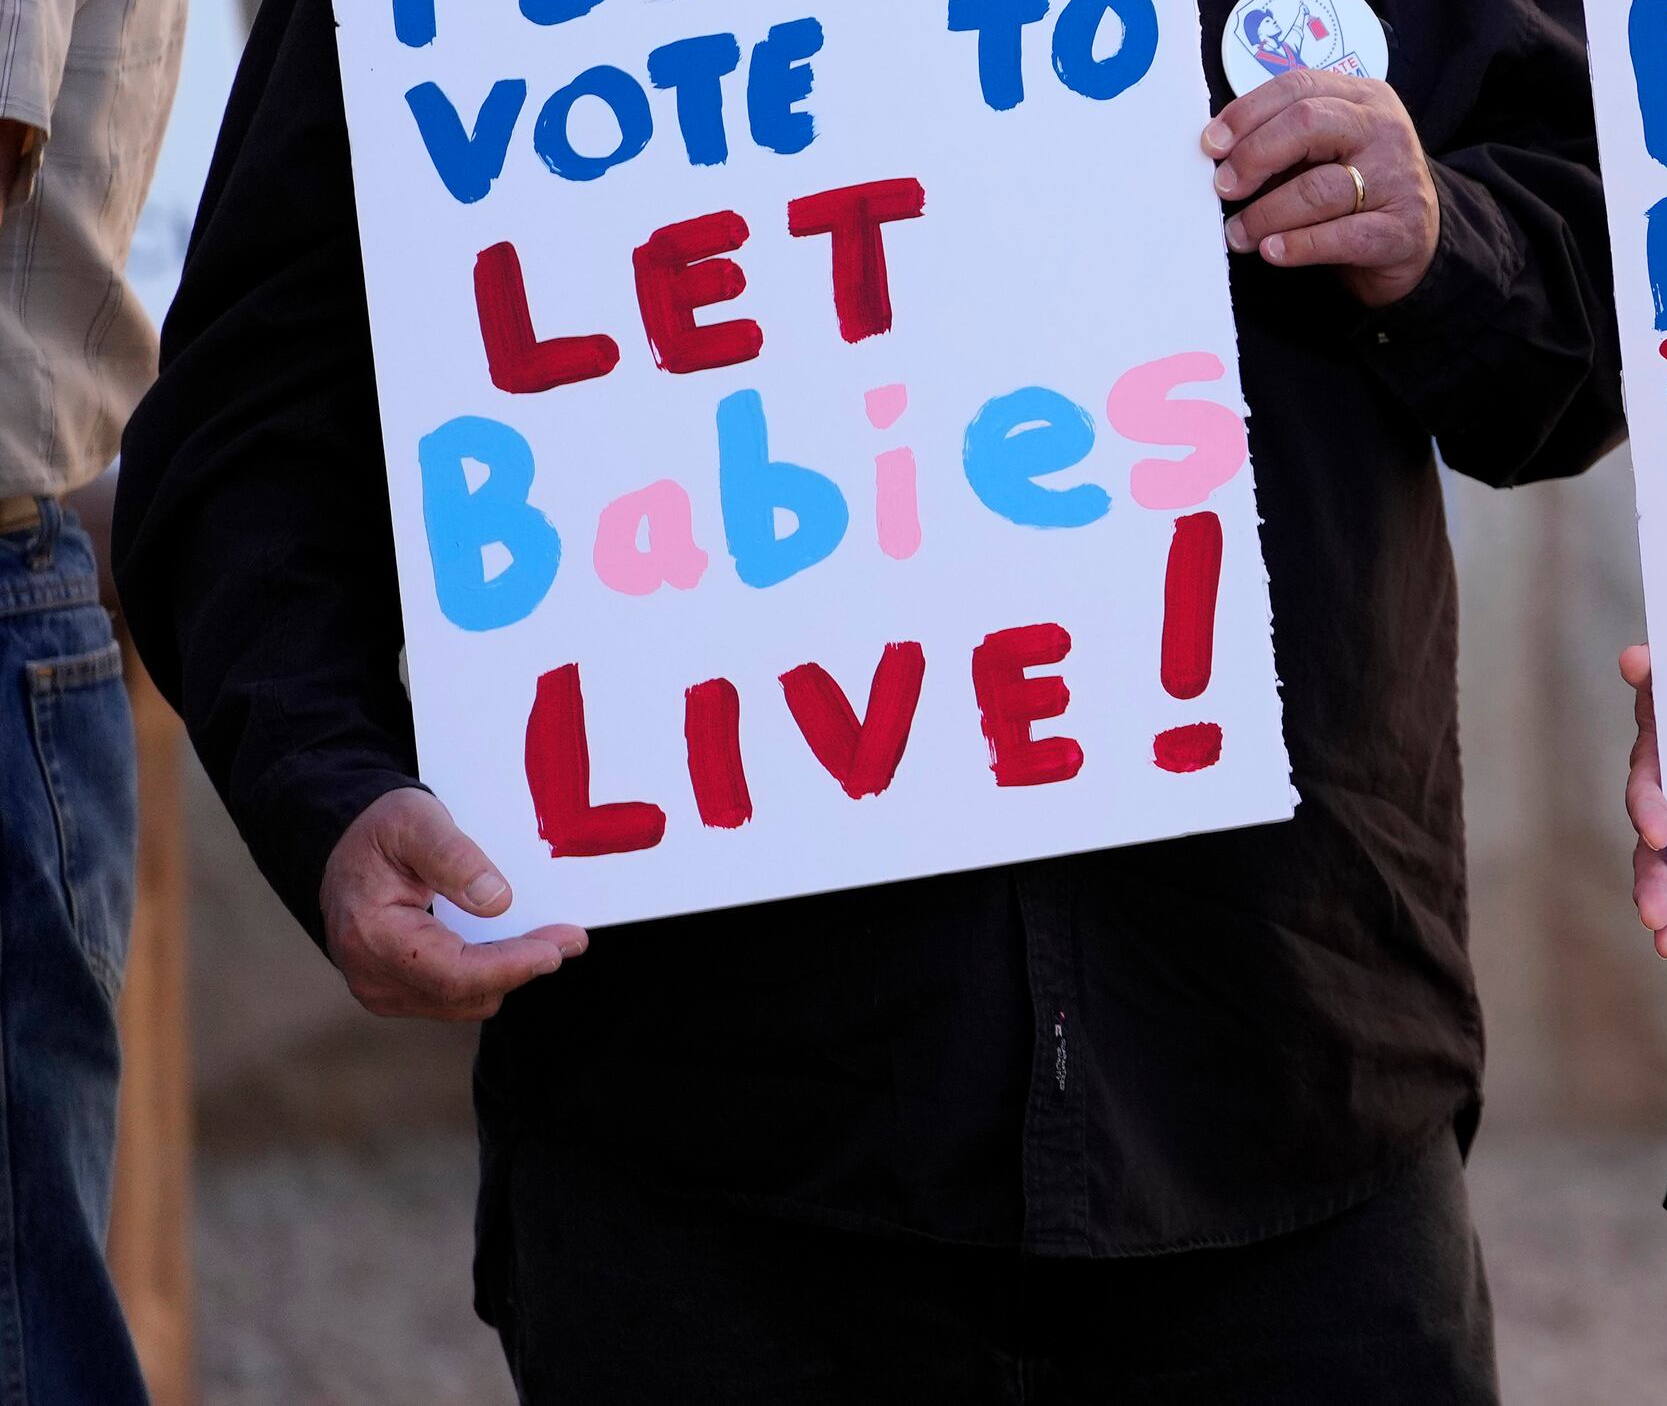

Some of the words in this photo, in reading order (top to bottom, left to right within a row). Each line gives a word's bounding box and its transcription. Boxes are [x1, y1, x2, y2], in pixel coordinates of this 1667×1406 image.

[406, 16, 824, 204] VOTE
[1328, 56, 1358, 75] ATE
[473, 177, 926, 395] LET
[418, 351, 1247, 631] Babies
[524, 511, 1223, 859] LIVE!
